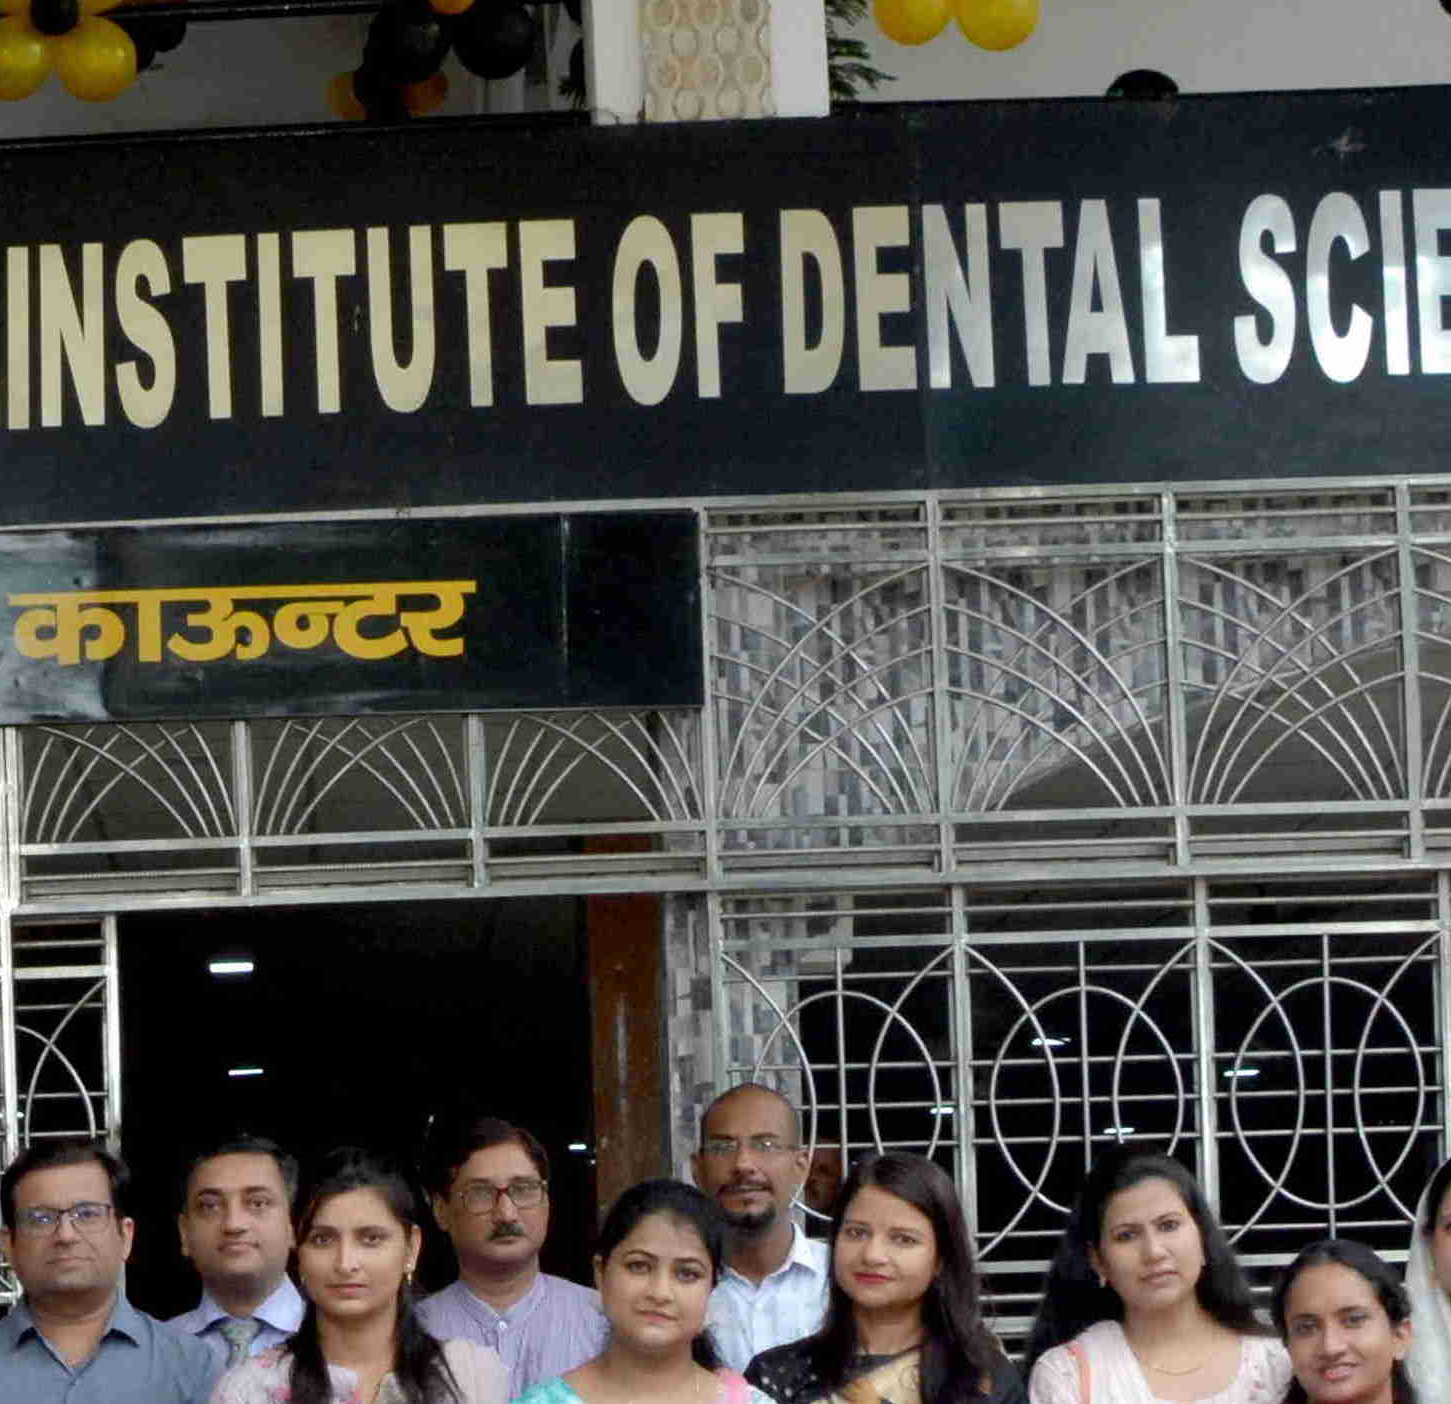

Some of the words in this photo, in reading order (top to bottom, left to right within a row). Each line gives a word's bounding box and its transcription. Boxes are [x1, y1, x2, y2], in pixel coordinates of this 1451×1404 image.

[612, 211, 745, 406] OF
[780, 197, 1202, 394] DENTAL
[9, 578, 478, 667] काऊन्टर
